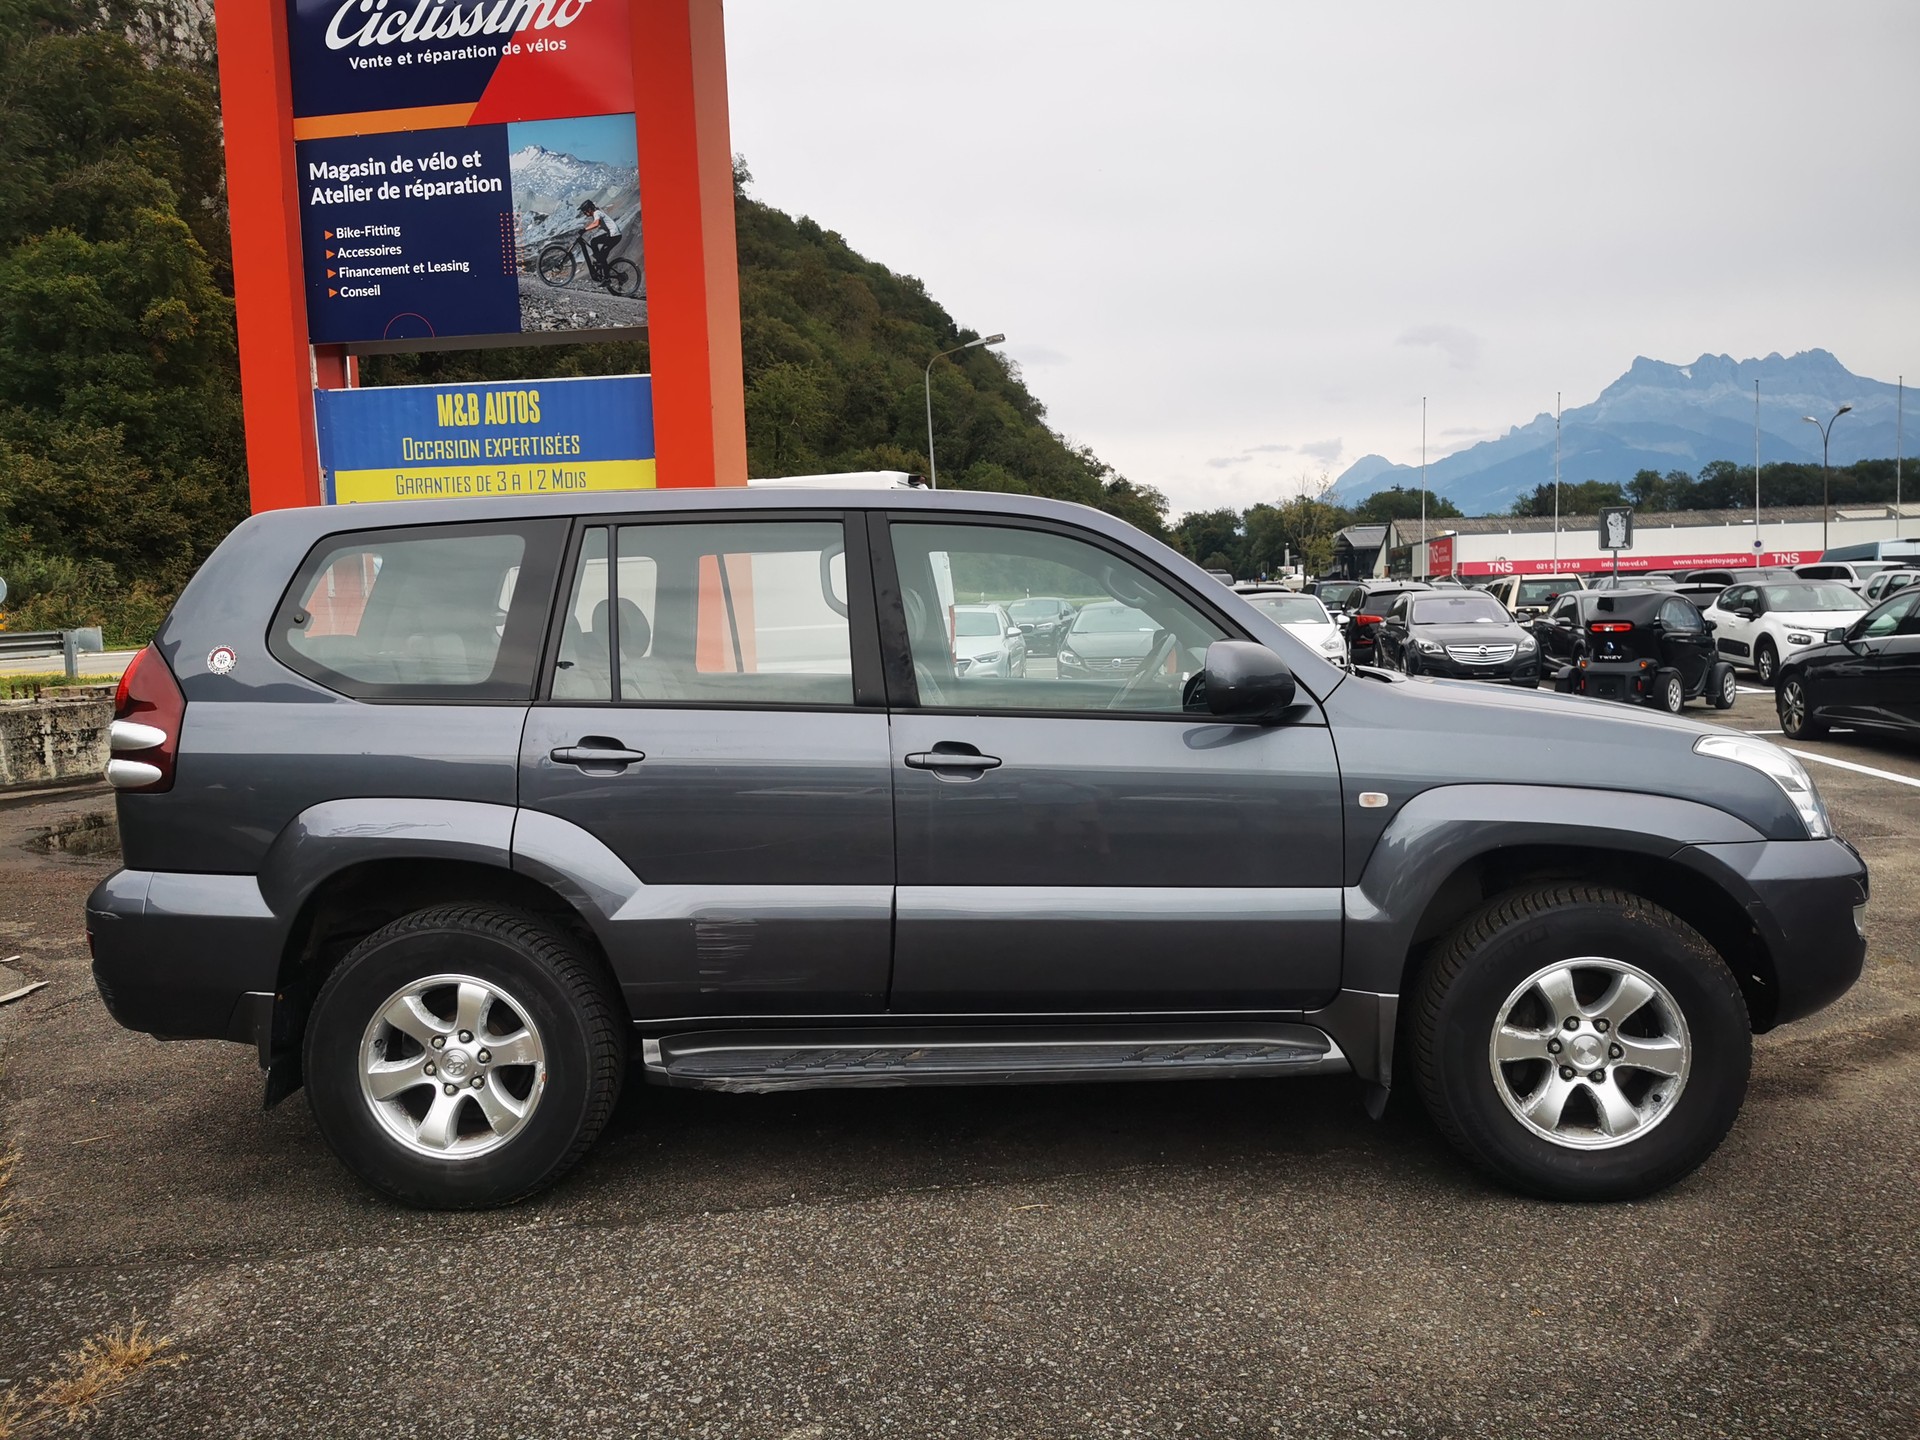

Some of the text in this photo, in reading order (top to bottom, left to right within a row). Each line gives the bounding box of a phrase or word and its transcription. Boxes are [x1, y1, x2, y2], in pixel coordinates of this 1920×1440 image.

[325, 0, 592, 50] Ciclissimo
[349, 39, 567, 70] Vente et réparation de vélos
[309, 150, 482, 182] Magasin de vélo et
[310, 174, 502, 206] Atelier de réparation
[336, 224, 401, 240] Bike-Fitting
[337, 244, 402, 259] Accessoires
[339, 259, 470, 279] Financement et Leasing
[340, 284, 381, 298] Conseil
[436, 390, 541, 427] M&B AUTOS
[497, 471, 507, 491] 3
[1487, 562, 1514, 573] TNS
[1601, 560, 1648, 568] infotns-vd.ch
[1673, 557, 1747, 566] www.tns-nettoyage.ch
[1773, 553, 1800, 564] TNS
